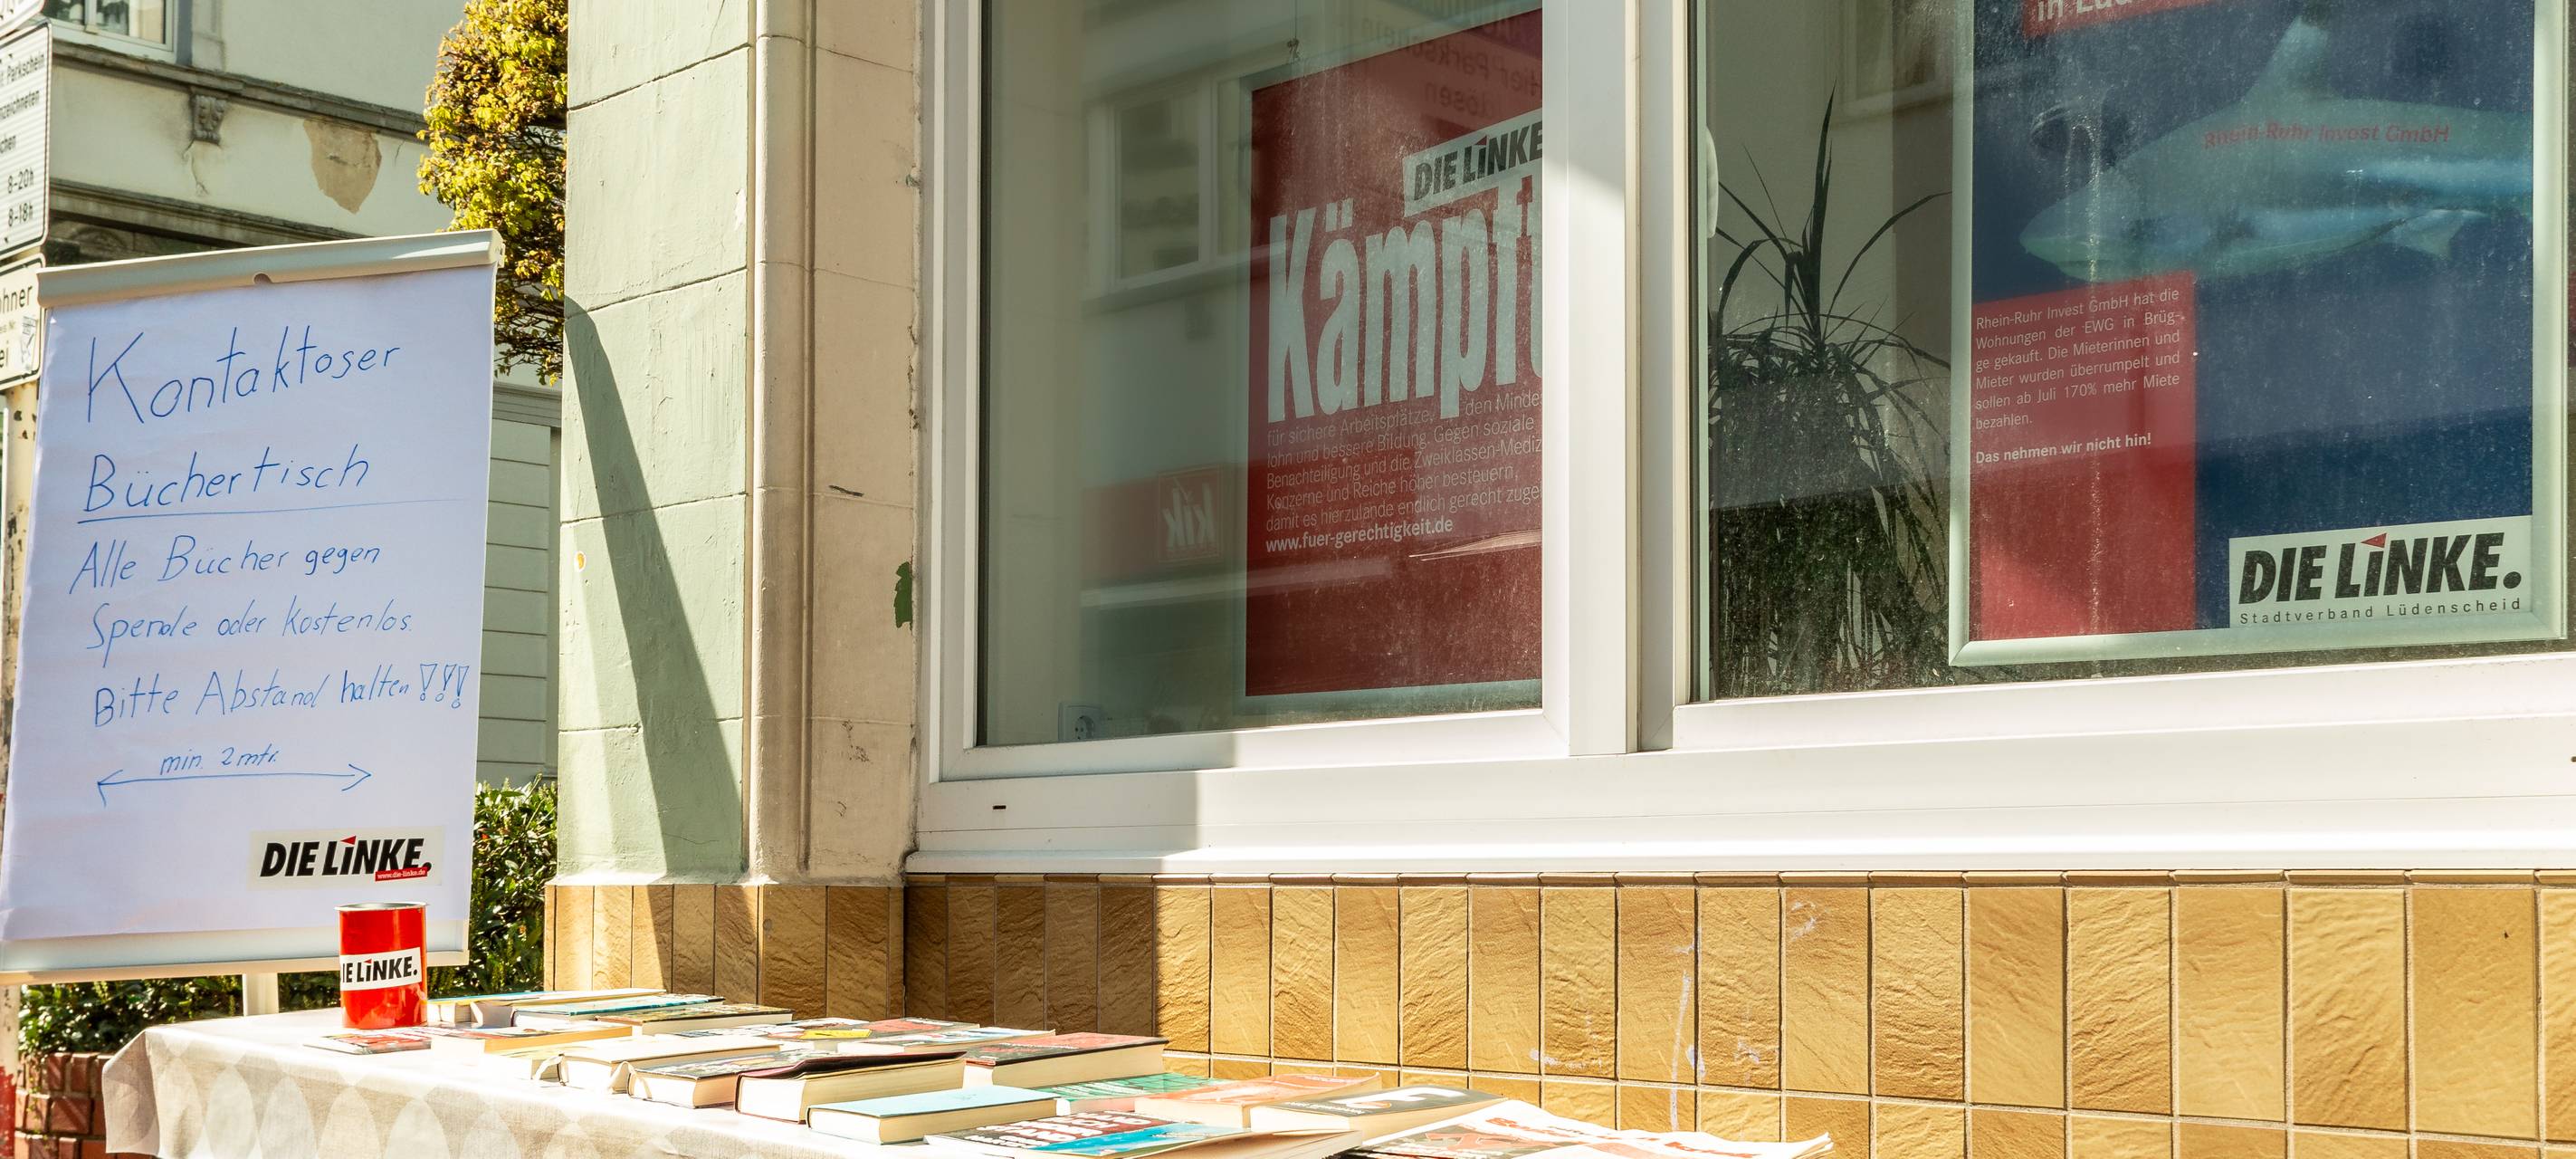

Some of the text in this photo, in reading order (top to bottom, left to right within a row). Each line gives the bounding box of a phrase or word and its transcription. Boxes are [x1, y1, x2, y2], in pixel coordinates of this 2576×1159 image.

[2319, 124, 2380, 142] Invest
[2385, 122, 2450, 143] GmbH
[7, 168, 33, 194] 8-20h
[1414, 151, 1458, 201] DIE
[7, 202, 33, 227] 8-18h
[1977, 289, 2179, 330] Rhein-Ruhr Invest GmbH hat die
[1976, 330, 2180, 372] ge gekauft. Die Mieterinnen und
[1977, 311, 2180, 350] Wohnungen der EWG in Brüg-
[88, 326, 400, 423] Kontaktoser
[1977, 351, 2180, 389] Mieter wurden überrumpelt und
[1976, 374, 2180, 409] sollen ab Juli 170% mehr Miete
[1268, 430, 1285, 446] für
[1289, 424, 1335, 442] sichere
[1340, 410, 1434, 436] Arbeitsplätze,
[1465, 398, 1491, 417] den
[1976, 414, 2032, 429] bezahlen.
[1268, 417, 1534, 468] lohn und bessere Bildung. Gegen soziale
[1976, 433, 2151, 464] Das nehmen wir nicht hin!
[83, 445, 369, 512] Büchertisch
[1268, 462, 1359, 489] Benachteiligung
[1365, 458, 1386, 476] und
[1391, 455, 1409, 471] die
[1268, 465, 1517, 510] Konzerne und Reiche höher besteuern,
[1266, 512, 1299, 532] damit
[1303, 512, 1317, 526] es
[1321, 503, 1393, 524] hierzulande
[1398, 494, 1445, 515] endlich
[1449, 490, 1502, 512] gerecht
[1266, 518, 1454, 552] www.fuer-gerechtigkeit.de
[70, 535, 380, 594] Alle Bücher gegen
[2238, 545, 2327, 605] DIE
[2240, 599, 2520, 624] Stadtverband Lüdenscheid
[86, 602, 196, 667] Spende
[218, 599, 267, 636] oder
[95, 673, 178, 728] Bitte
[195, 668, 331, 715] Abstand
[260, 841, 320, 876] DIE
